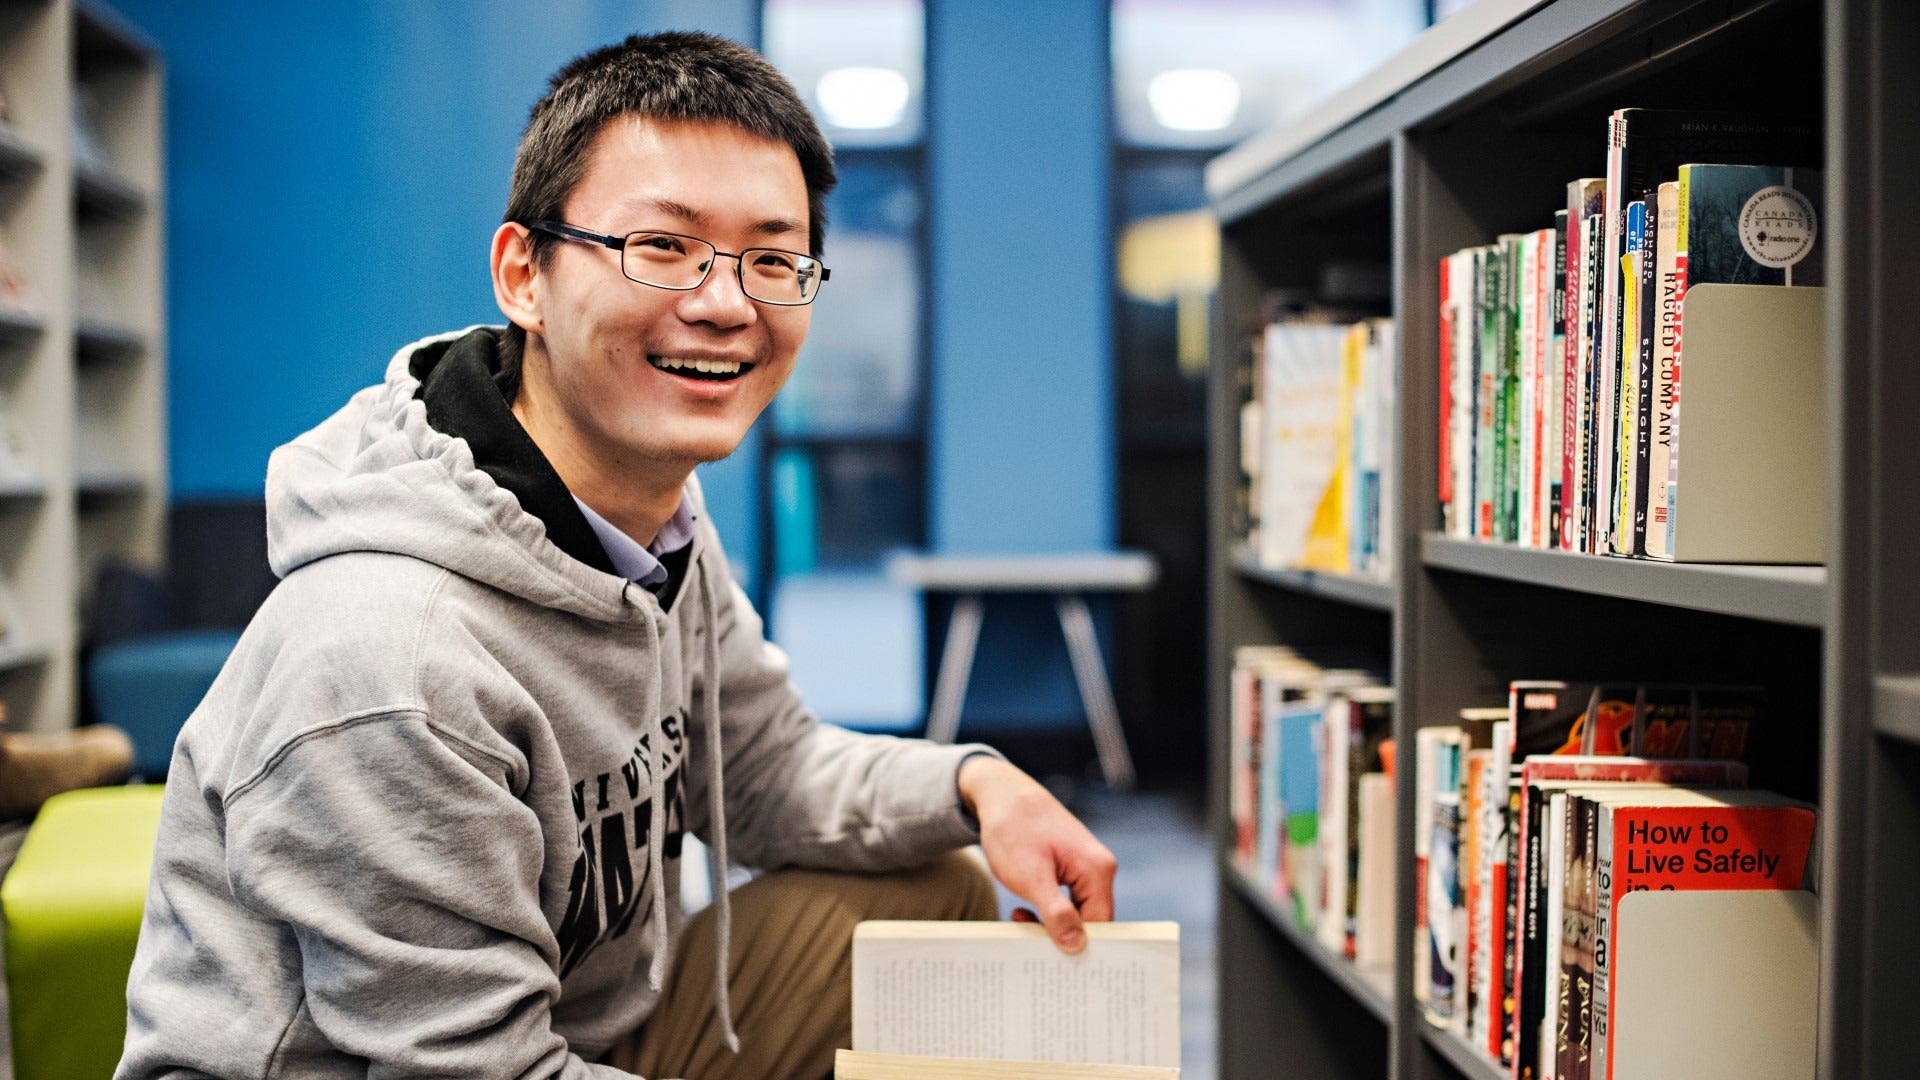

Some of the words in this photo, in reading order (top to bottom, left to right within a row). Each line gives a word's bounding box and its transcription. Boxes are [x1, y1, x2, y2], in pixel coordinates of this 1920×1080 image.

[1743, 200, 1760, 228] CANADA
[1755, 220, 1803, 228] READS
[1646, 215, 1655, 280] RICHARD
[1661, 272, 1677, 348] RAGGED
[1673, 267, 1685, 367] INDIAN
[1640, 338, 1650, 459] STARLIGHT
[1658, 357, 1674, 448] COMPANY
[1603, 530, 1609, 544] 3
[1628, 820, 1692, 844] How
[1700, 821, 1729, 845] to
[1598, 867, 1611, 890] to
[1627, 850, 1685, 873] Live
[1692, 849, 1780, 879] Safely
[1596, 911, 1607, 937] in
[1595, 938, 1606, 968] a
[1559, 972, 1570, 1054] FAUNA
[1577, 976, 1591, 1063] FAUNA
